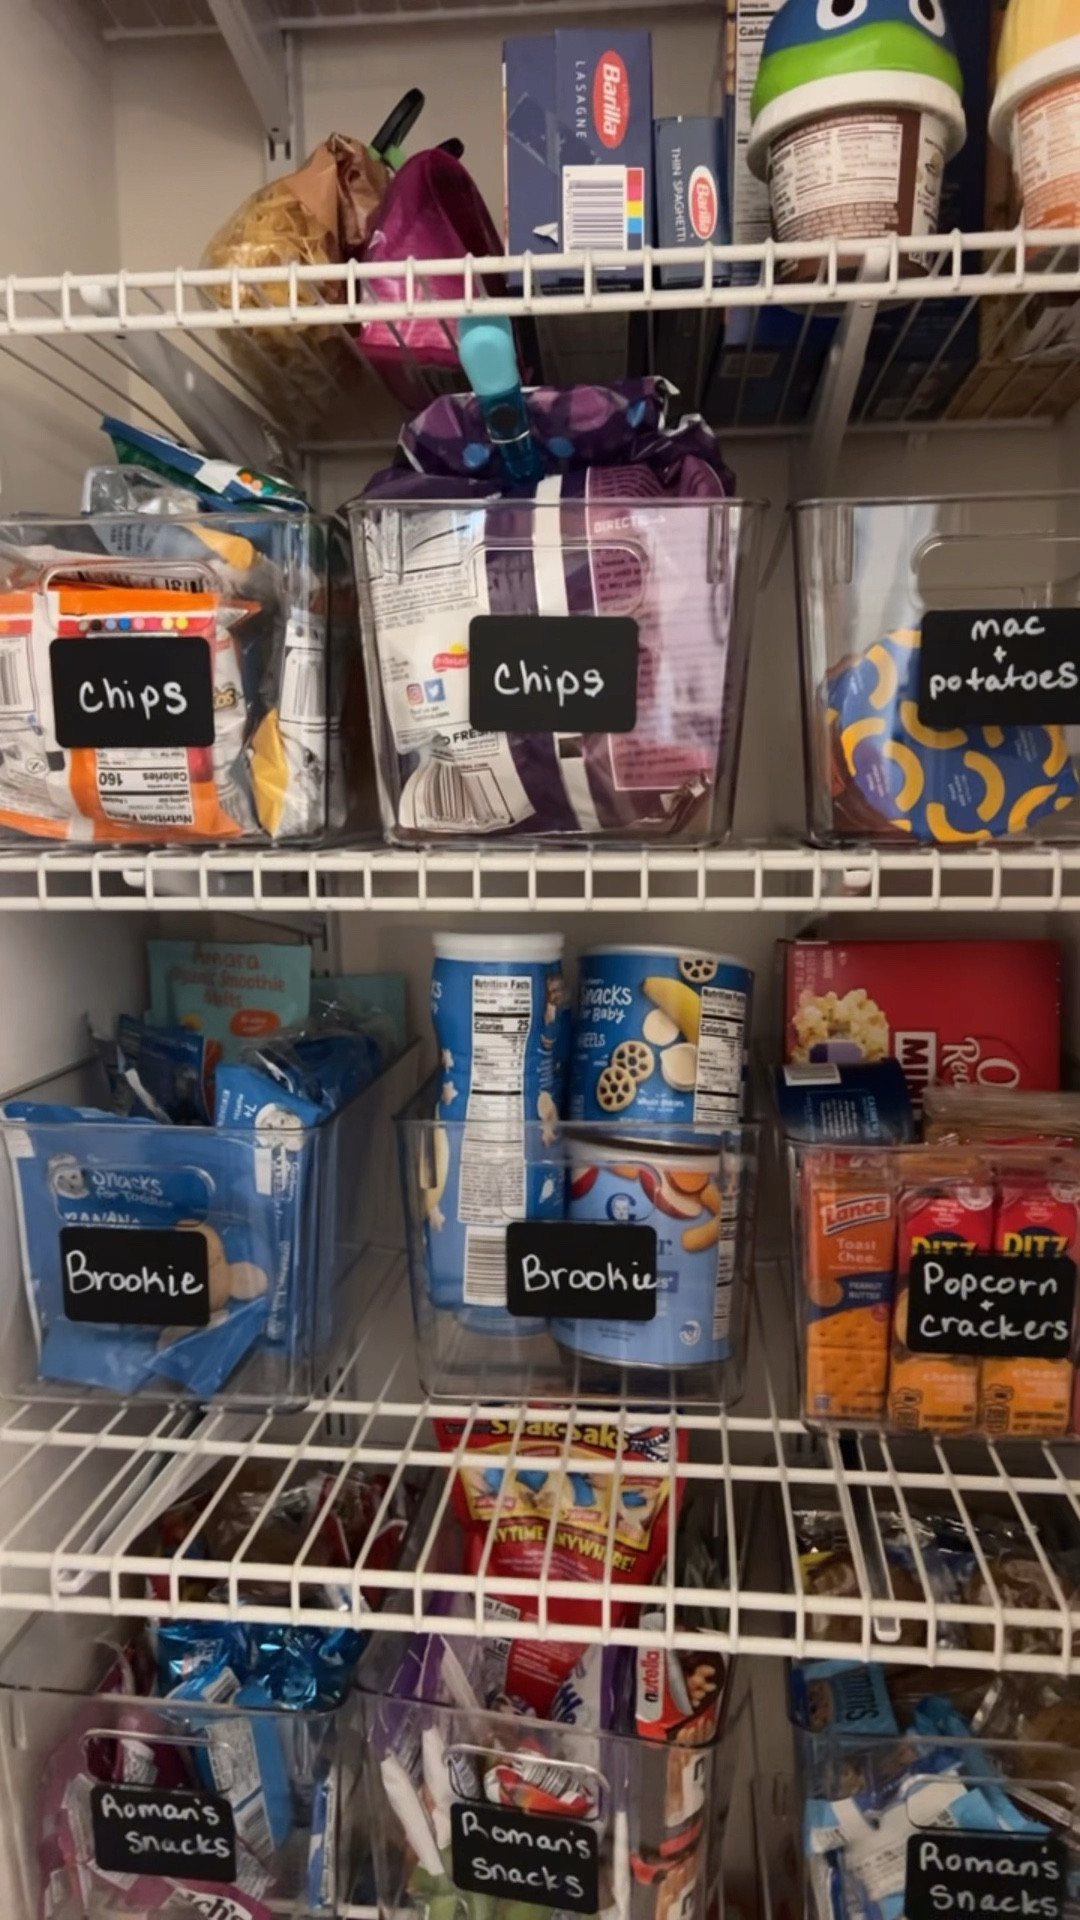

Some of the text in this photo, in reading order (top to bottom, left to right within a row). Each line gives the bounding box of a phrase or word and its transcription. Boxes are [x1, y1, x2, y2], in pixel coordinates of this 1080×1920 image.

[575, 60, 587, 139] LASAGNE
[602, 62, 621, 137] Barilla
[672, 147, 686, 243] THIN SPAGHETTI
[696, 183, 712, 235] Barilla
[971, 616, 1045, 640] mac
[929, 661, 1078, 699] potatoes
[99, 772, 187, 786] 160 Calories
[517, 1019, 529, 1031] 25
[825, 1200, 887, 1227] Lance
[837, 1238, 877, 1250] Toast
[66, 1249, 205, 1297] Brookie
[924, 1261, 1058, 1301] Popcorn
[641, 1651, 660, 1704] nutella
